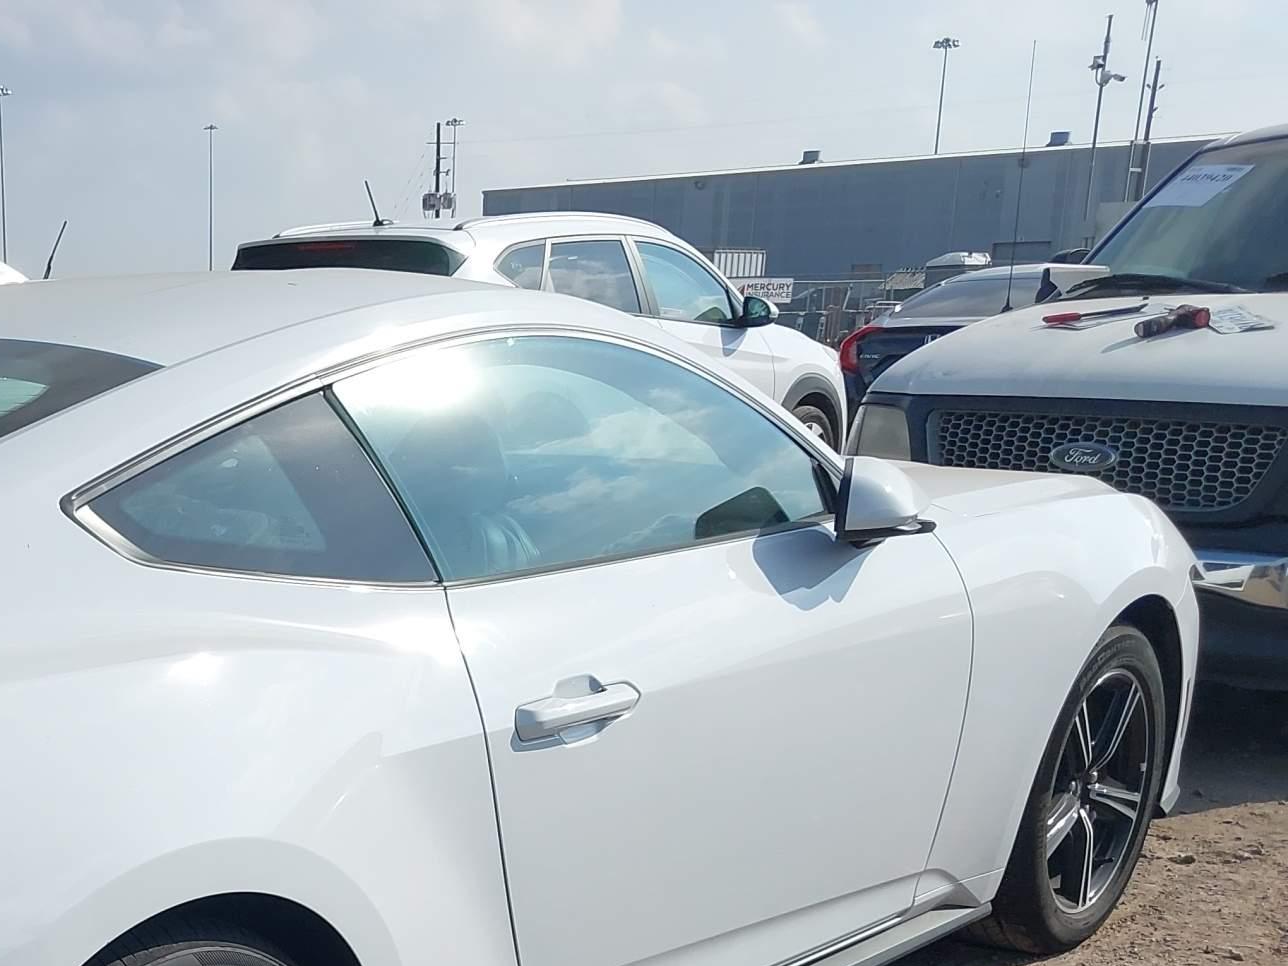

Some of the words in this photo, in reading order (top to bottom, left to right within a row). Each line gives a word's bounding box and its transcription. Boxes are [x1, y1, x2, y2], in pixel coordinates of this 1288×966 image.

[746, 282, 792, 291] MERCURY
[746, 291, 792, 299] INSURANCE
[1064, 447, 1102, 467] Ford
